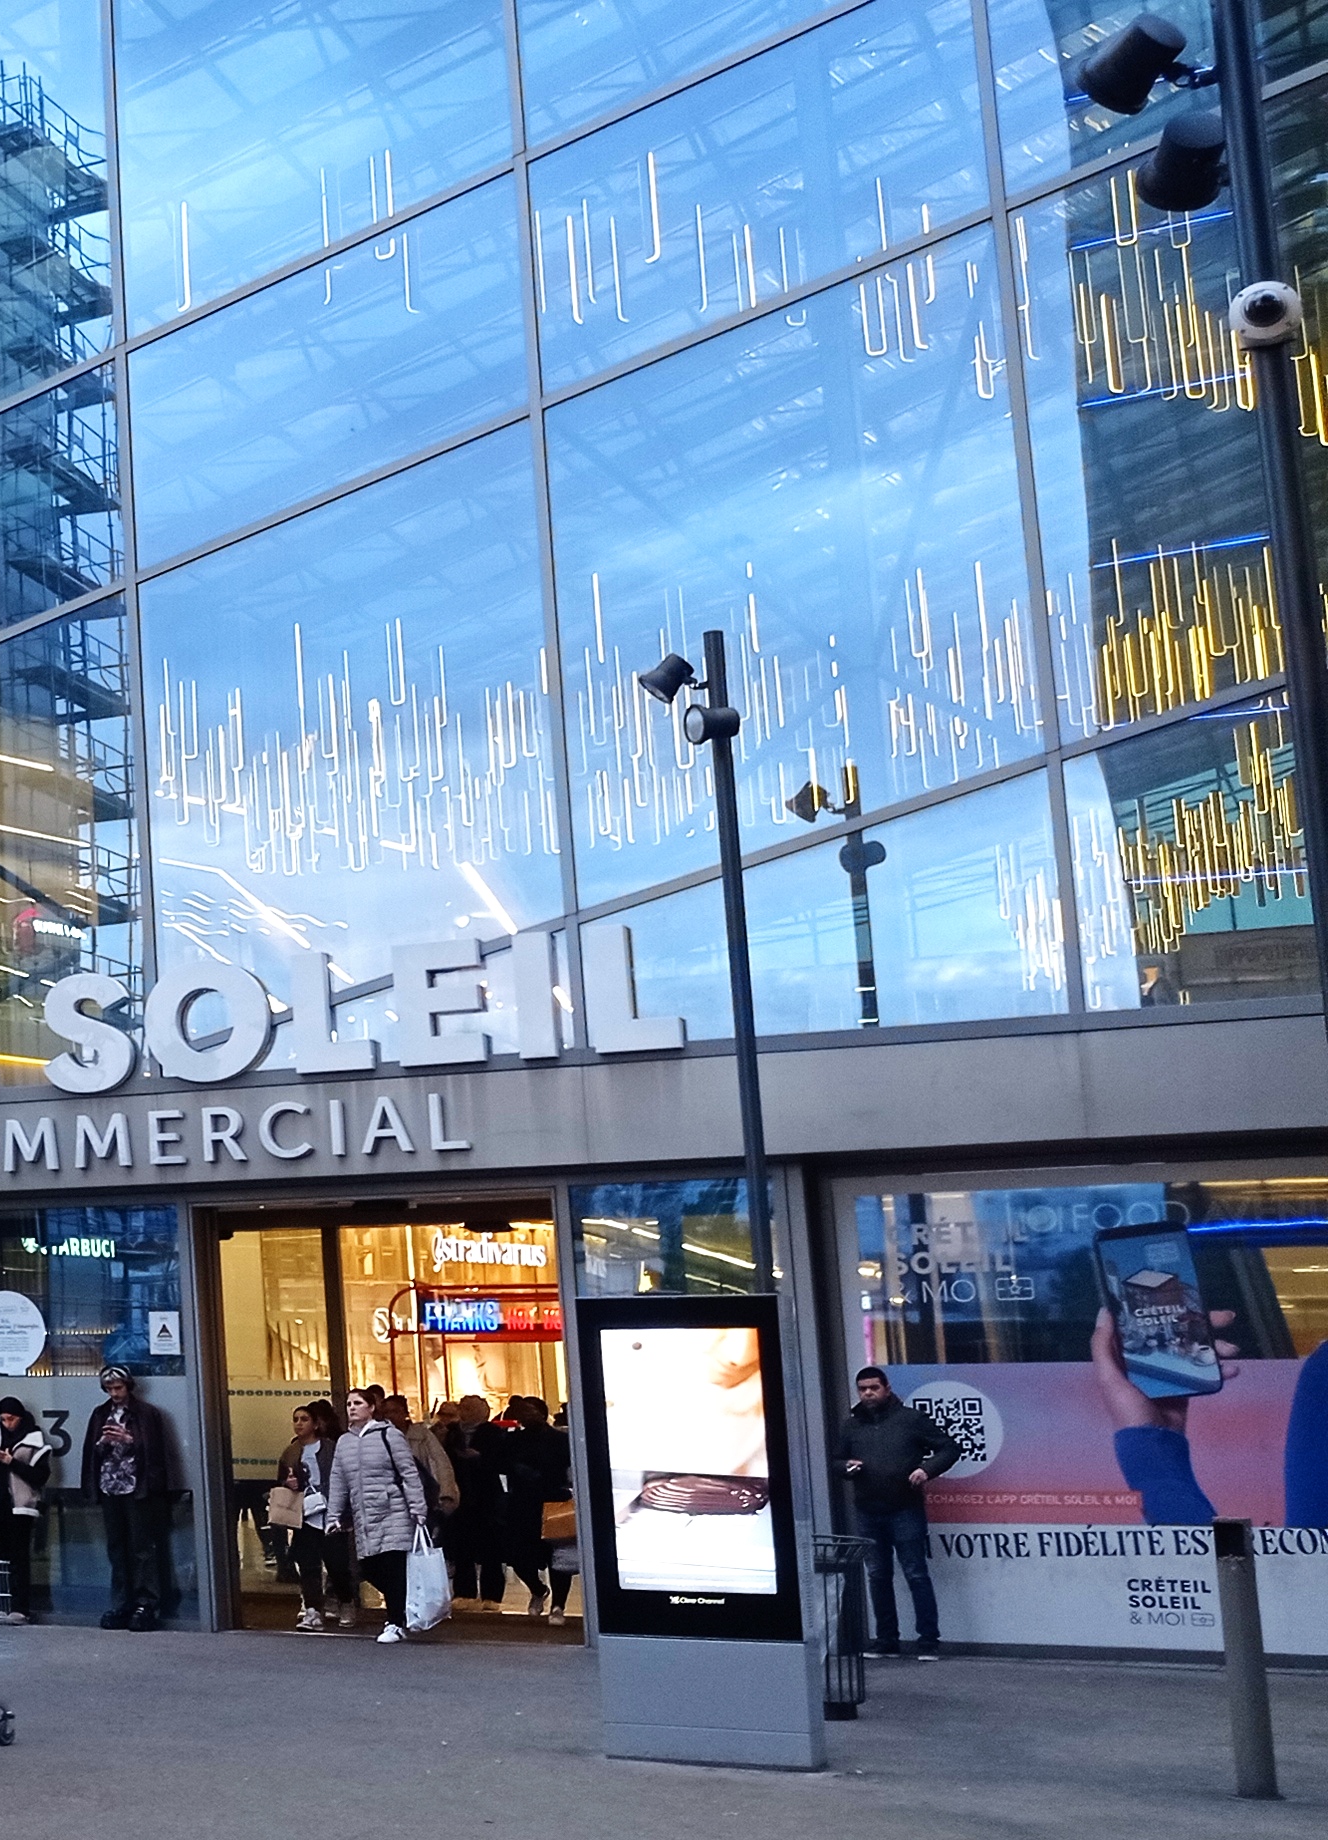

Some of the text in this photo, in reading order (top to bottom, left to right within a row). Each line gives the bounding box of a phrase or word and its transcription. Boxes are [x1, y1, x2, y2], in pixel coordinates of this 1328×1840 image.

[44, 925, 687, 1094] SOLEIL
[432, 1227, 548, 1273] Stradivarius
[1135, 1314, 1179, 1327] SOLEIL
[41, 1409, 73, 1458] 3
[940, 1532, 1031, 1559] VOTRE
[1039, 1525, 1165, 1559] FIDÉLITÉ
[1127, 1576, 1212, 1594] CRÉTEIL
[1128, 1595, 1202, 1610] SOLEIL
[1129, 1611, 1186, 1626] & MOI
